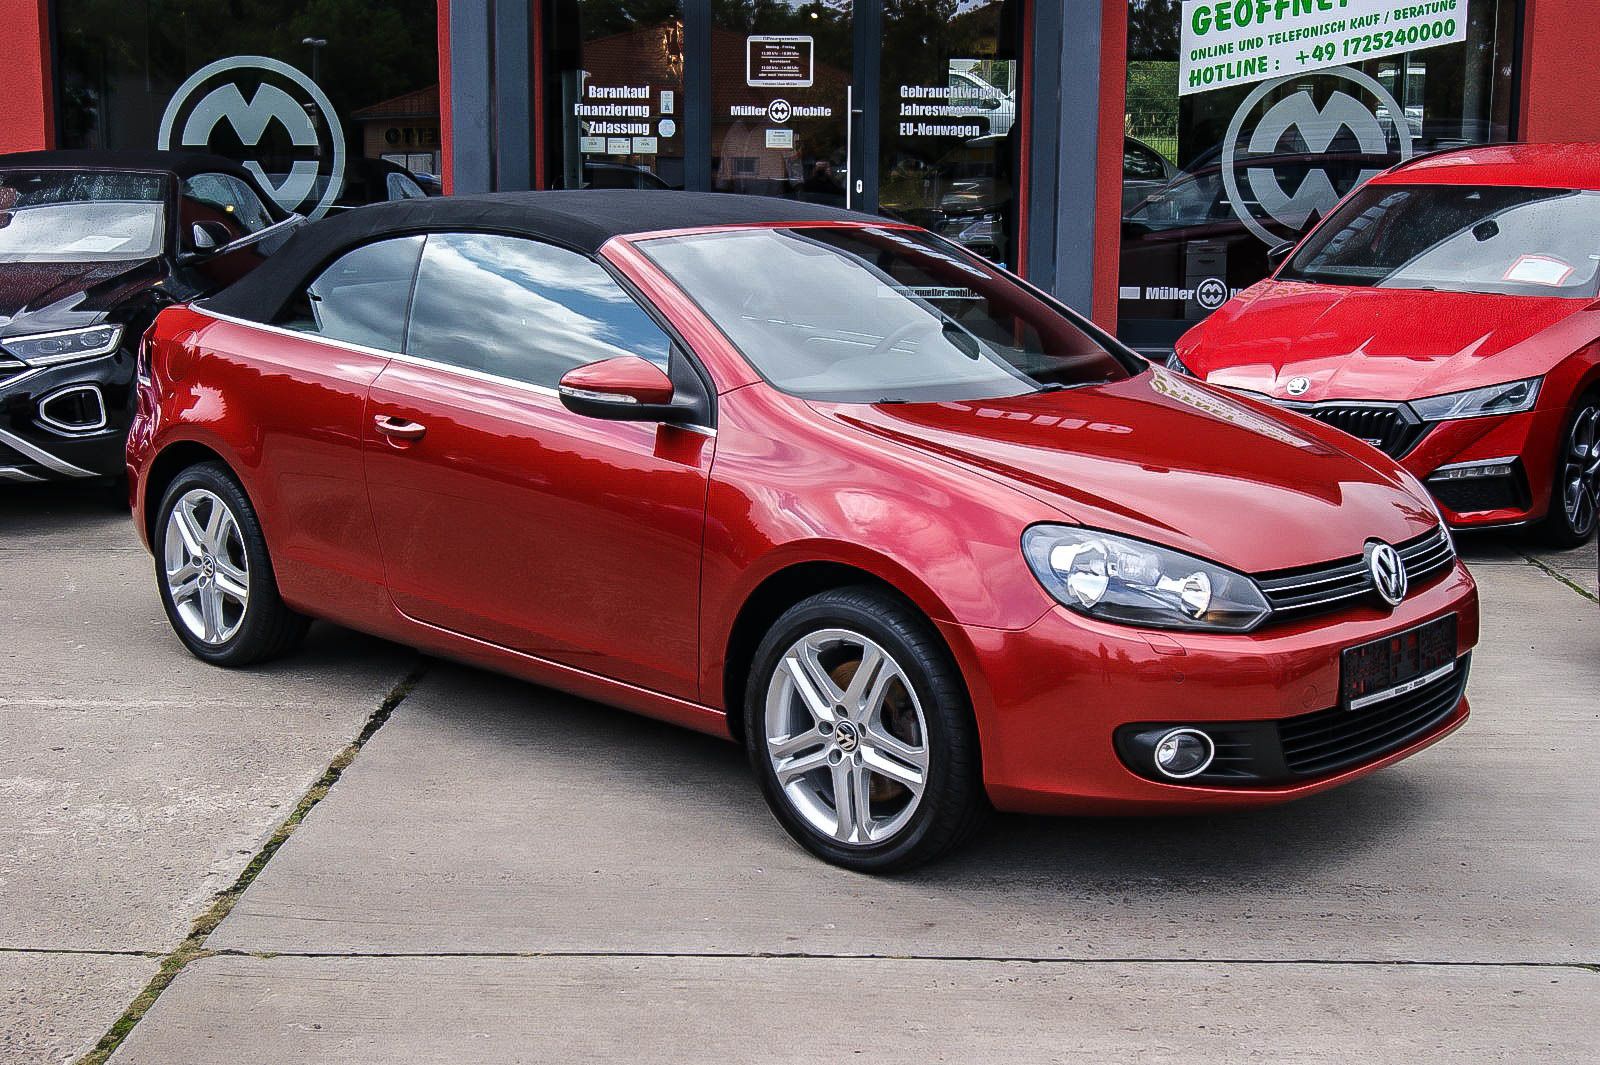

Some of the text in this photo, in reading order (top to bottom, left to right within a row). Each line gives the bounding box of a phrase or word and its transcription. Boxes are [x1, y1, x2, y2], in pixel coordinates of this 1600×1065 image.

[1190, 42, 1234, 61] ONLINE
[1238, 37, 1264, 51] UND
[1267, 20, 1345, 46] TELEFONISCH
[1350, 14, 1380, 29] KAUF
[1394, 0, 1456, 20] BERATUNG
[1189, 56, 1268, 87] HOTLINE
[1295, 42, 1336, 65] +49
[1342, 19, 1456, 57] 1725240000
[574, 103, 650, 118] Finanzierung
[730, 105, 832, 117] Müller Mobile
[899, 103, 979, 117] Jahreswagen
[589, 121, 650, 135] Zulassung
[899, 122, 980, 137] EU-Neuwagen
[1145, 286, 1196, 300] Müller
